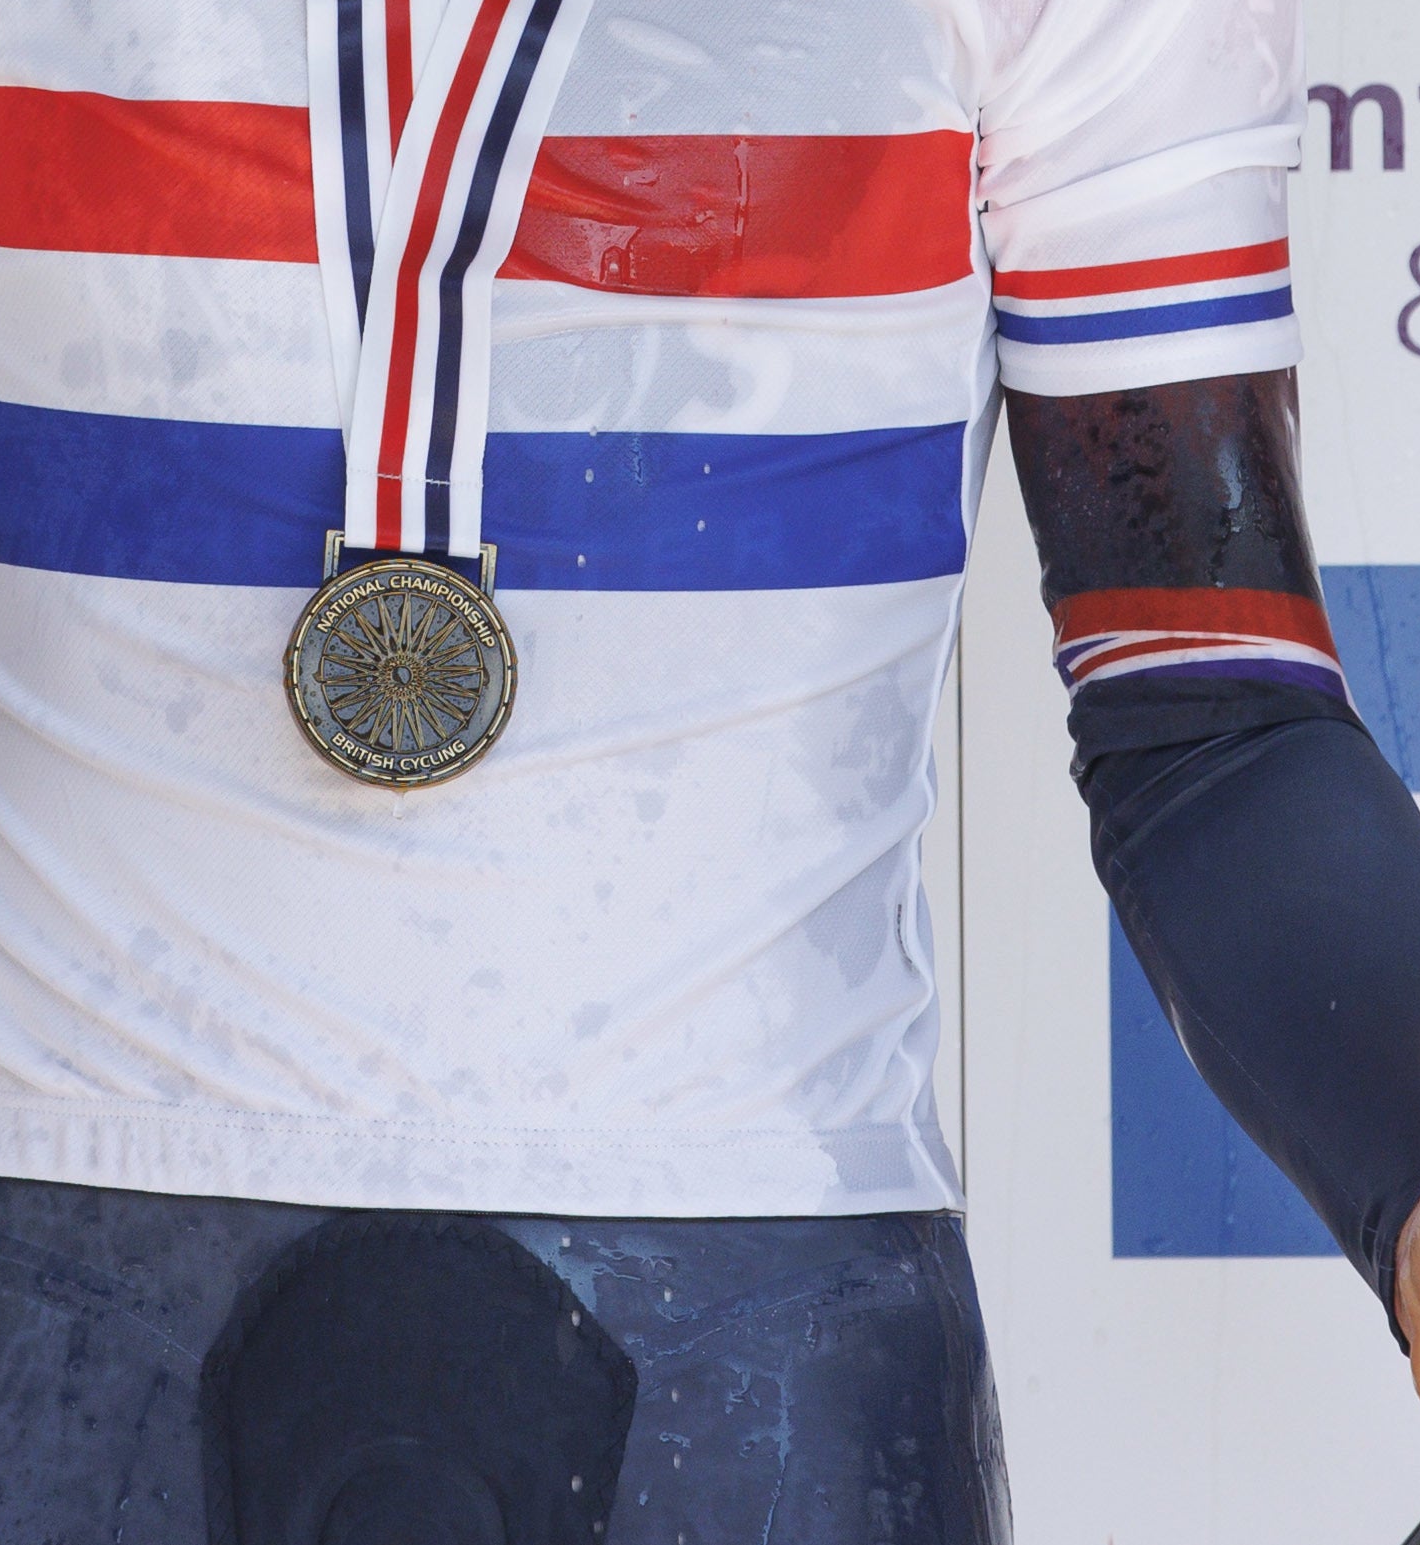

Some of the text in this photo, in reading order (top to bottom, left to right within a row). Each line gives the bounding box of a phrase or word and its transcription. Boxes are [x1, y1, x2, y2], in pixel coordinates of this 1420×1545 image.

[317, 575, 497, 648] NATIONAL CHAMPIONSHIP
[331, 732, 467, 771] BRITISH CYCLING
